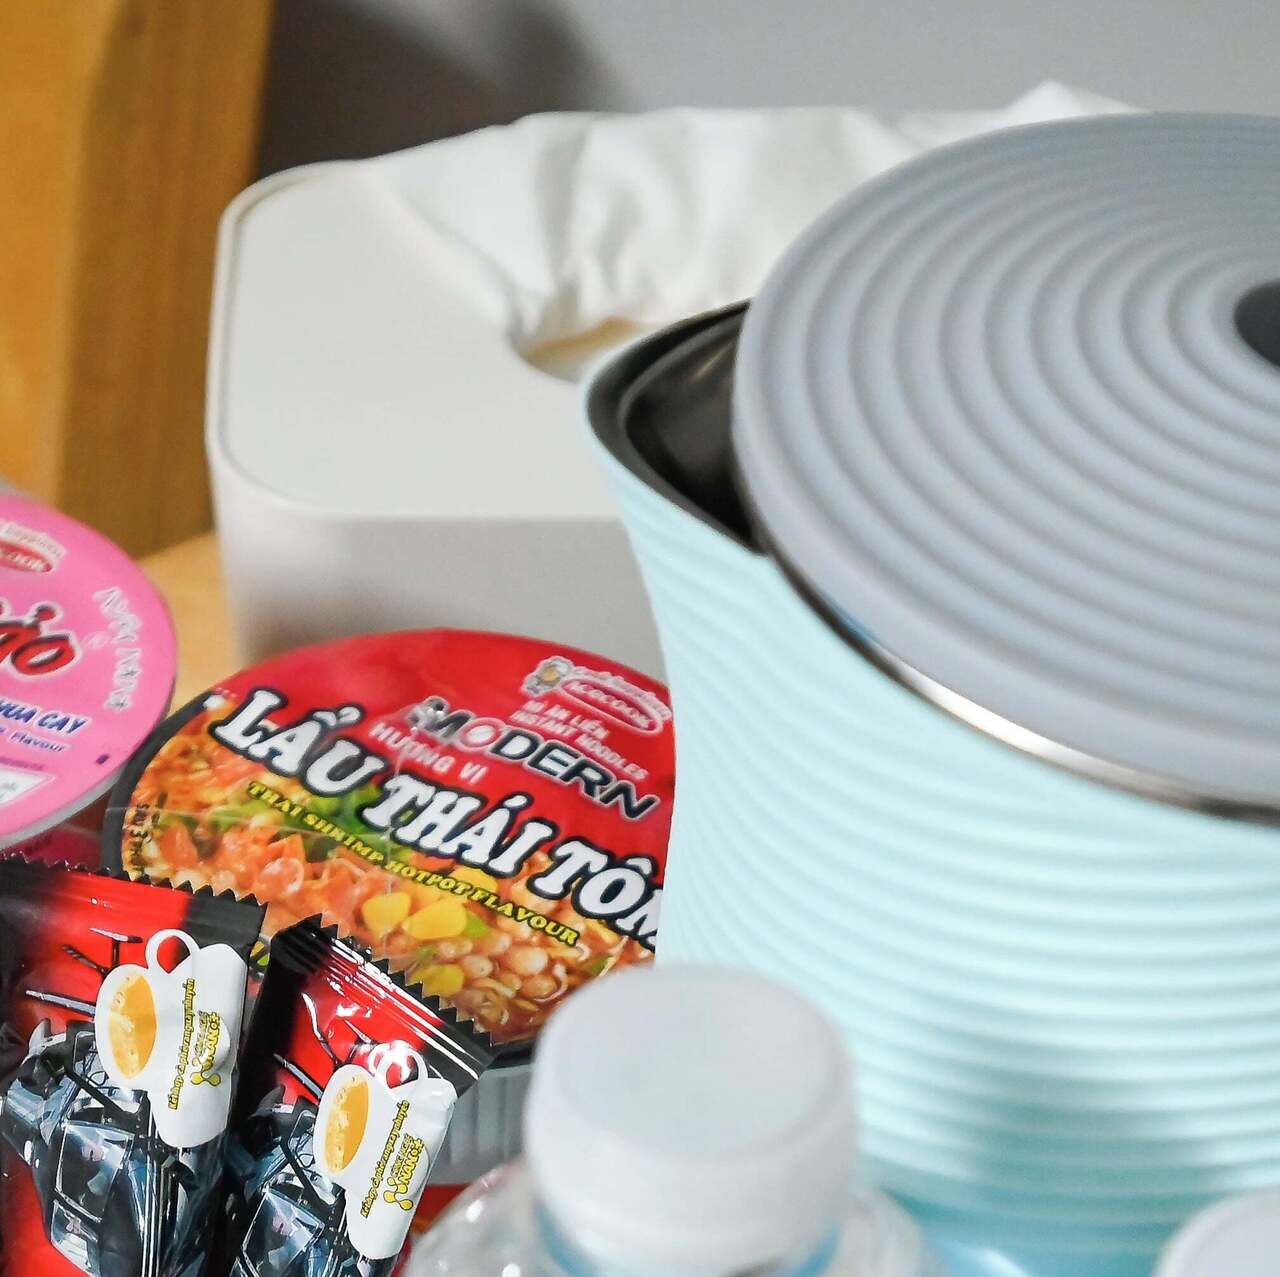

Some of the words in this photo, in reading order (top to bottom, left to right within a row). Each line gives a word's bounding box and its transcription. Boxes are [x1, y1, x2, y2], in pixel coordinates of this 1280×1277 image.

[10, 731, 67, 753] Flavour
[39, 711, 90, 735] CAY
[407, 697, 658, 822] MODERN
[575, 733, 649, 782] NOODLES
[215, 689, 384, 796] LẨU
[362, 774, 554, 876] THÁI
[247, 780, 300, 817] THAI
[303, 813, 385, 863] SHRIMP
[384, 861, 472, 900] HOTPOT
[470, 886, 581, 946] FLAVOUR
